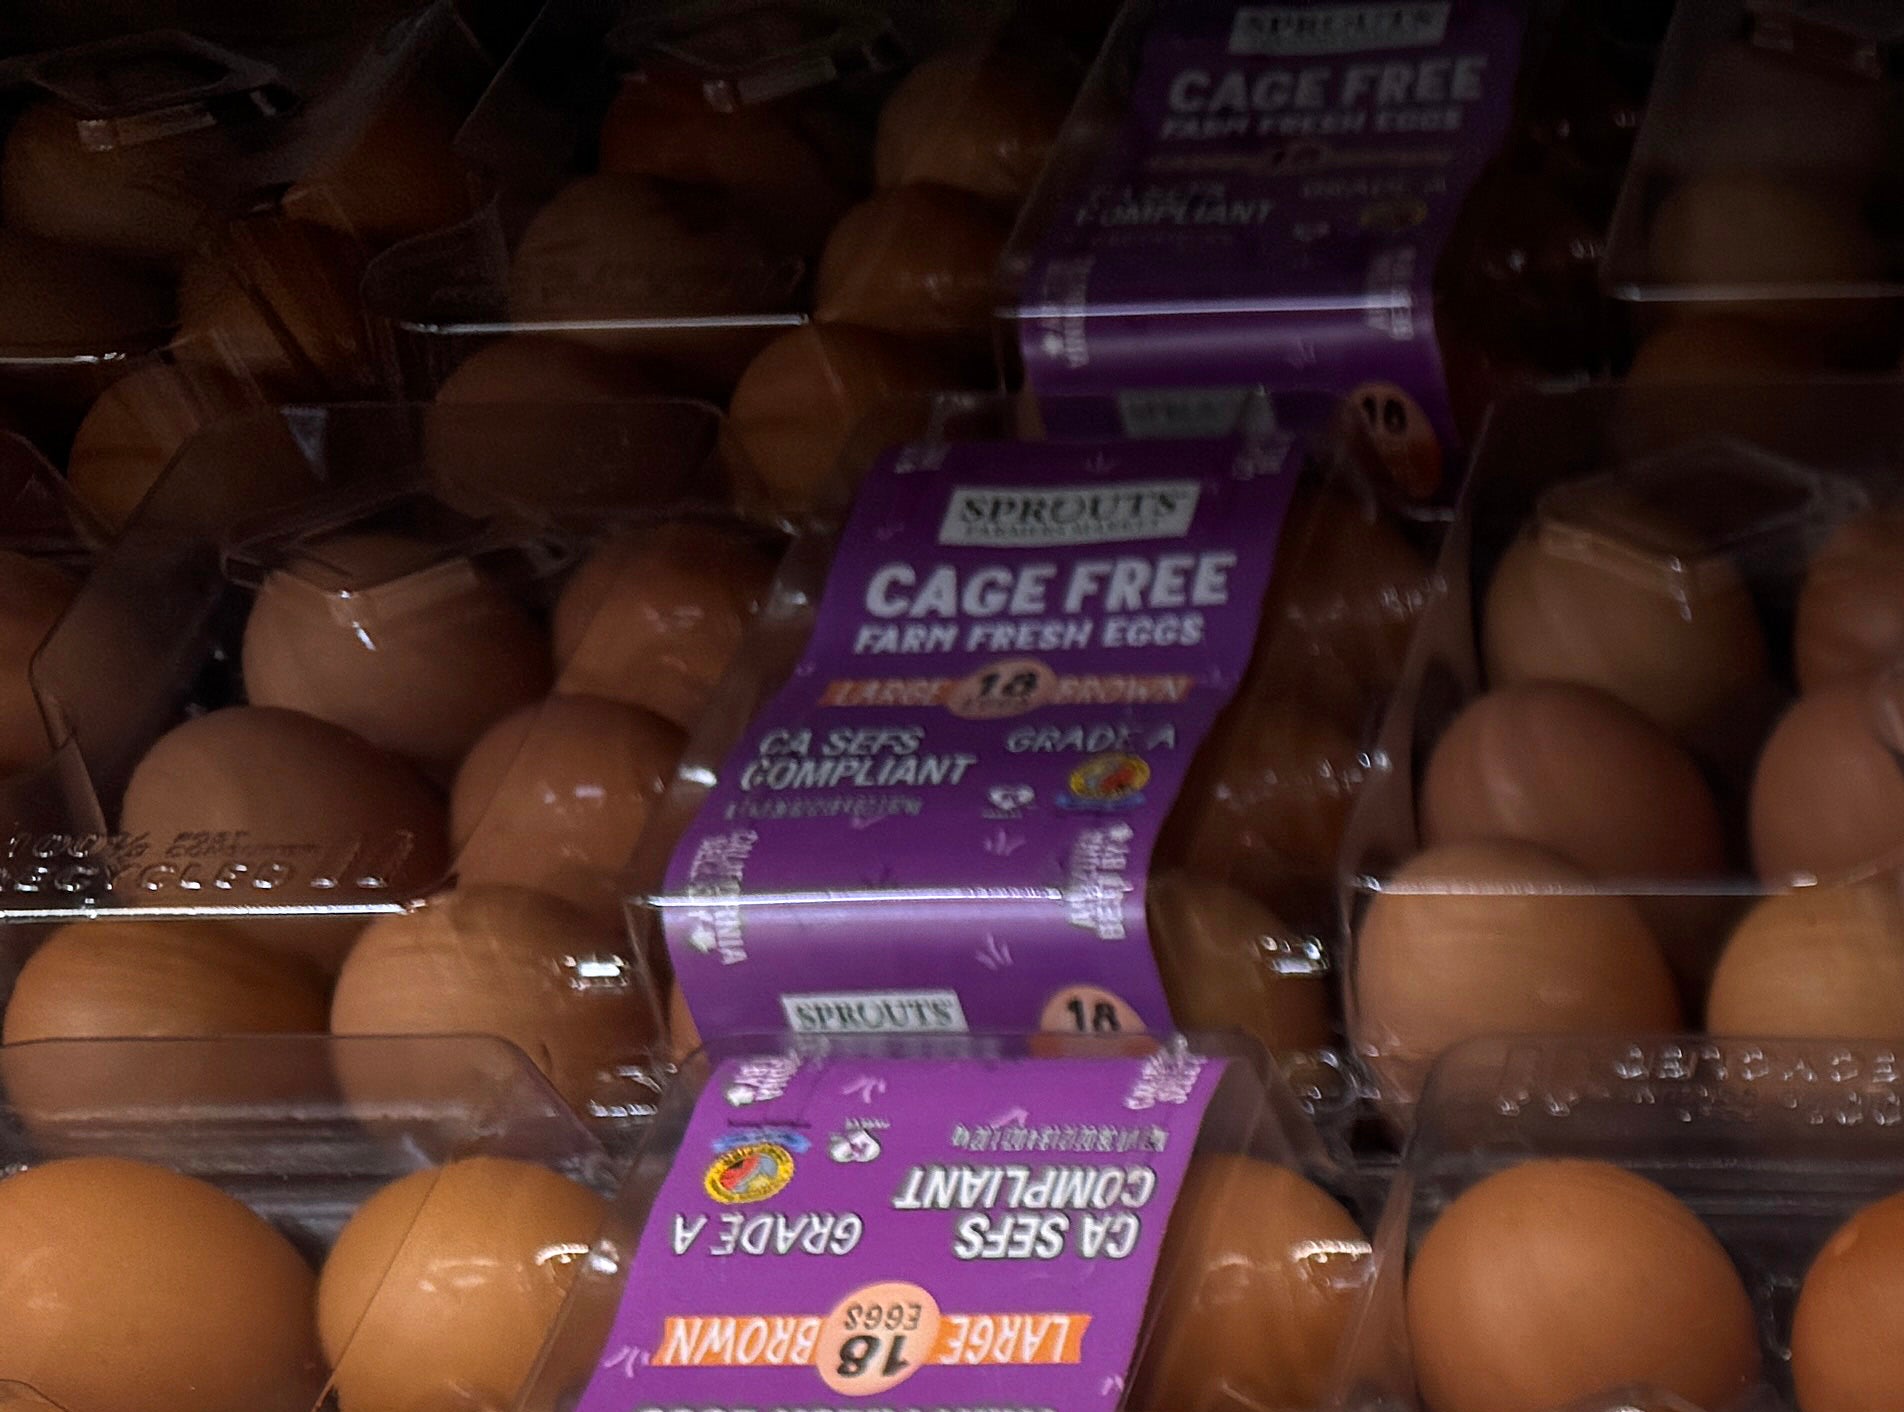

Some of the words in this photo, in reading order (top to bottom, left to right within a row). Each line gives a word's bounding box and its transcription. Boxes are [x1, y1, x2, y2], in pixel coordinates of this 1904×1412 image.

[866, 564, 1055, 619] CAGE
[1066, 553, 1236, 609] FREE
[894, 1166, 1156, 1210] COMPLIANT
[673, 1215, 708, 1253] A
[711, 1215, 864, 1255] GRADE
[955, 1214, 1070, 1260] SEFS
[1081, 1215, 1141, 1259] CA
[843, 1303, 923, 1331] EGGS
[664, 1318, 816, 1365] BROWN
[836, 1333, 911, 1377] 18
[946, 1315, 1072, 1364] LARGE
